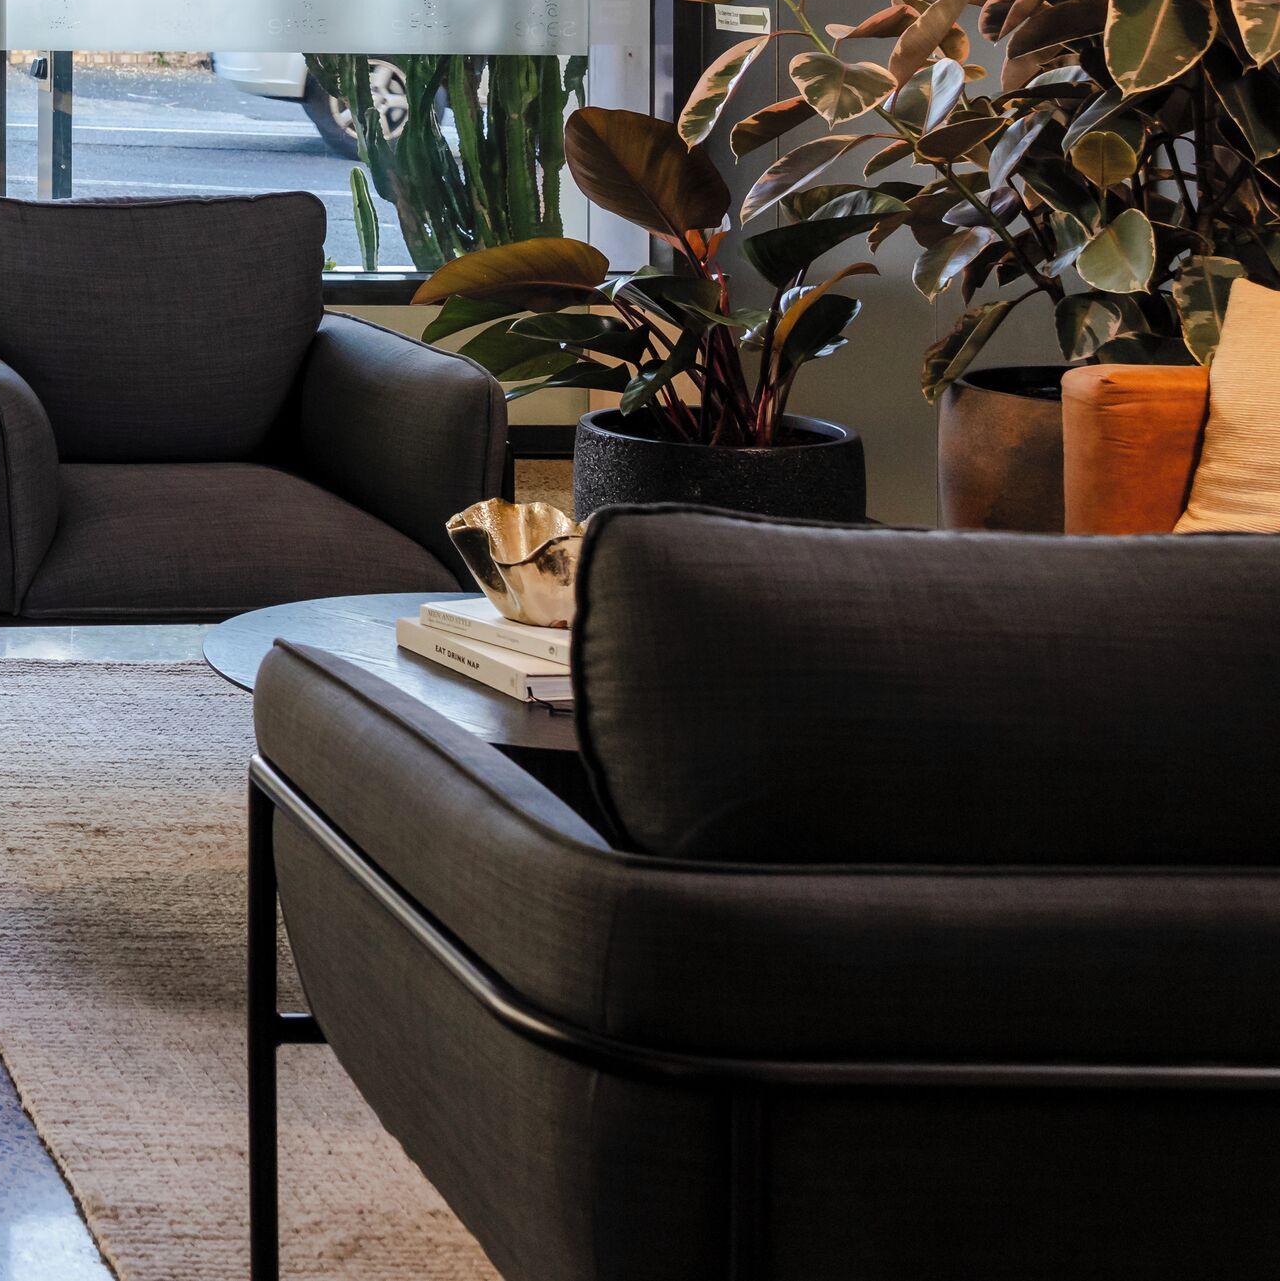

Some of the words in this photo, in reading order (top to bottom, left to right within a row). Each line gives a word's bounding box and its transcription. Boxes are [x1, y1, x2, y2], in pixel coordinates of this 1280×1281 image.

[435, 644, 446, 655] EAT
[447, 650, 466, 665] DRINK
[466, 659, 480, 670] NAP
